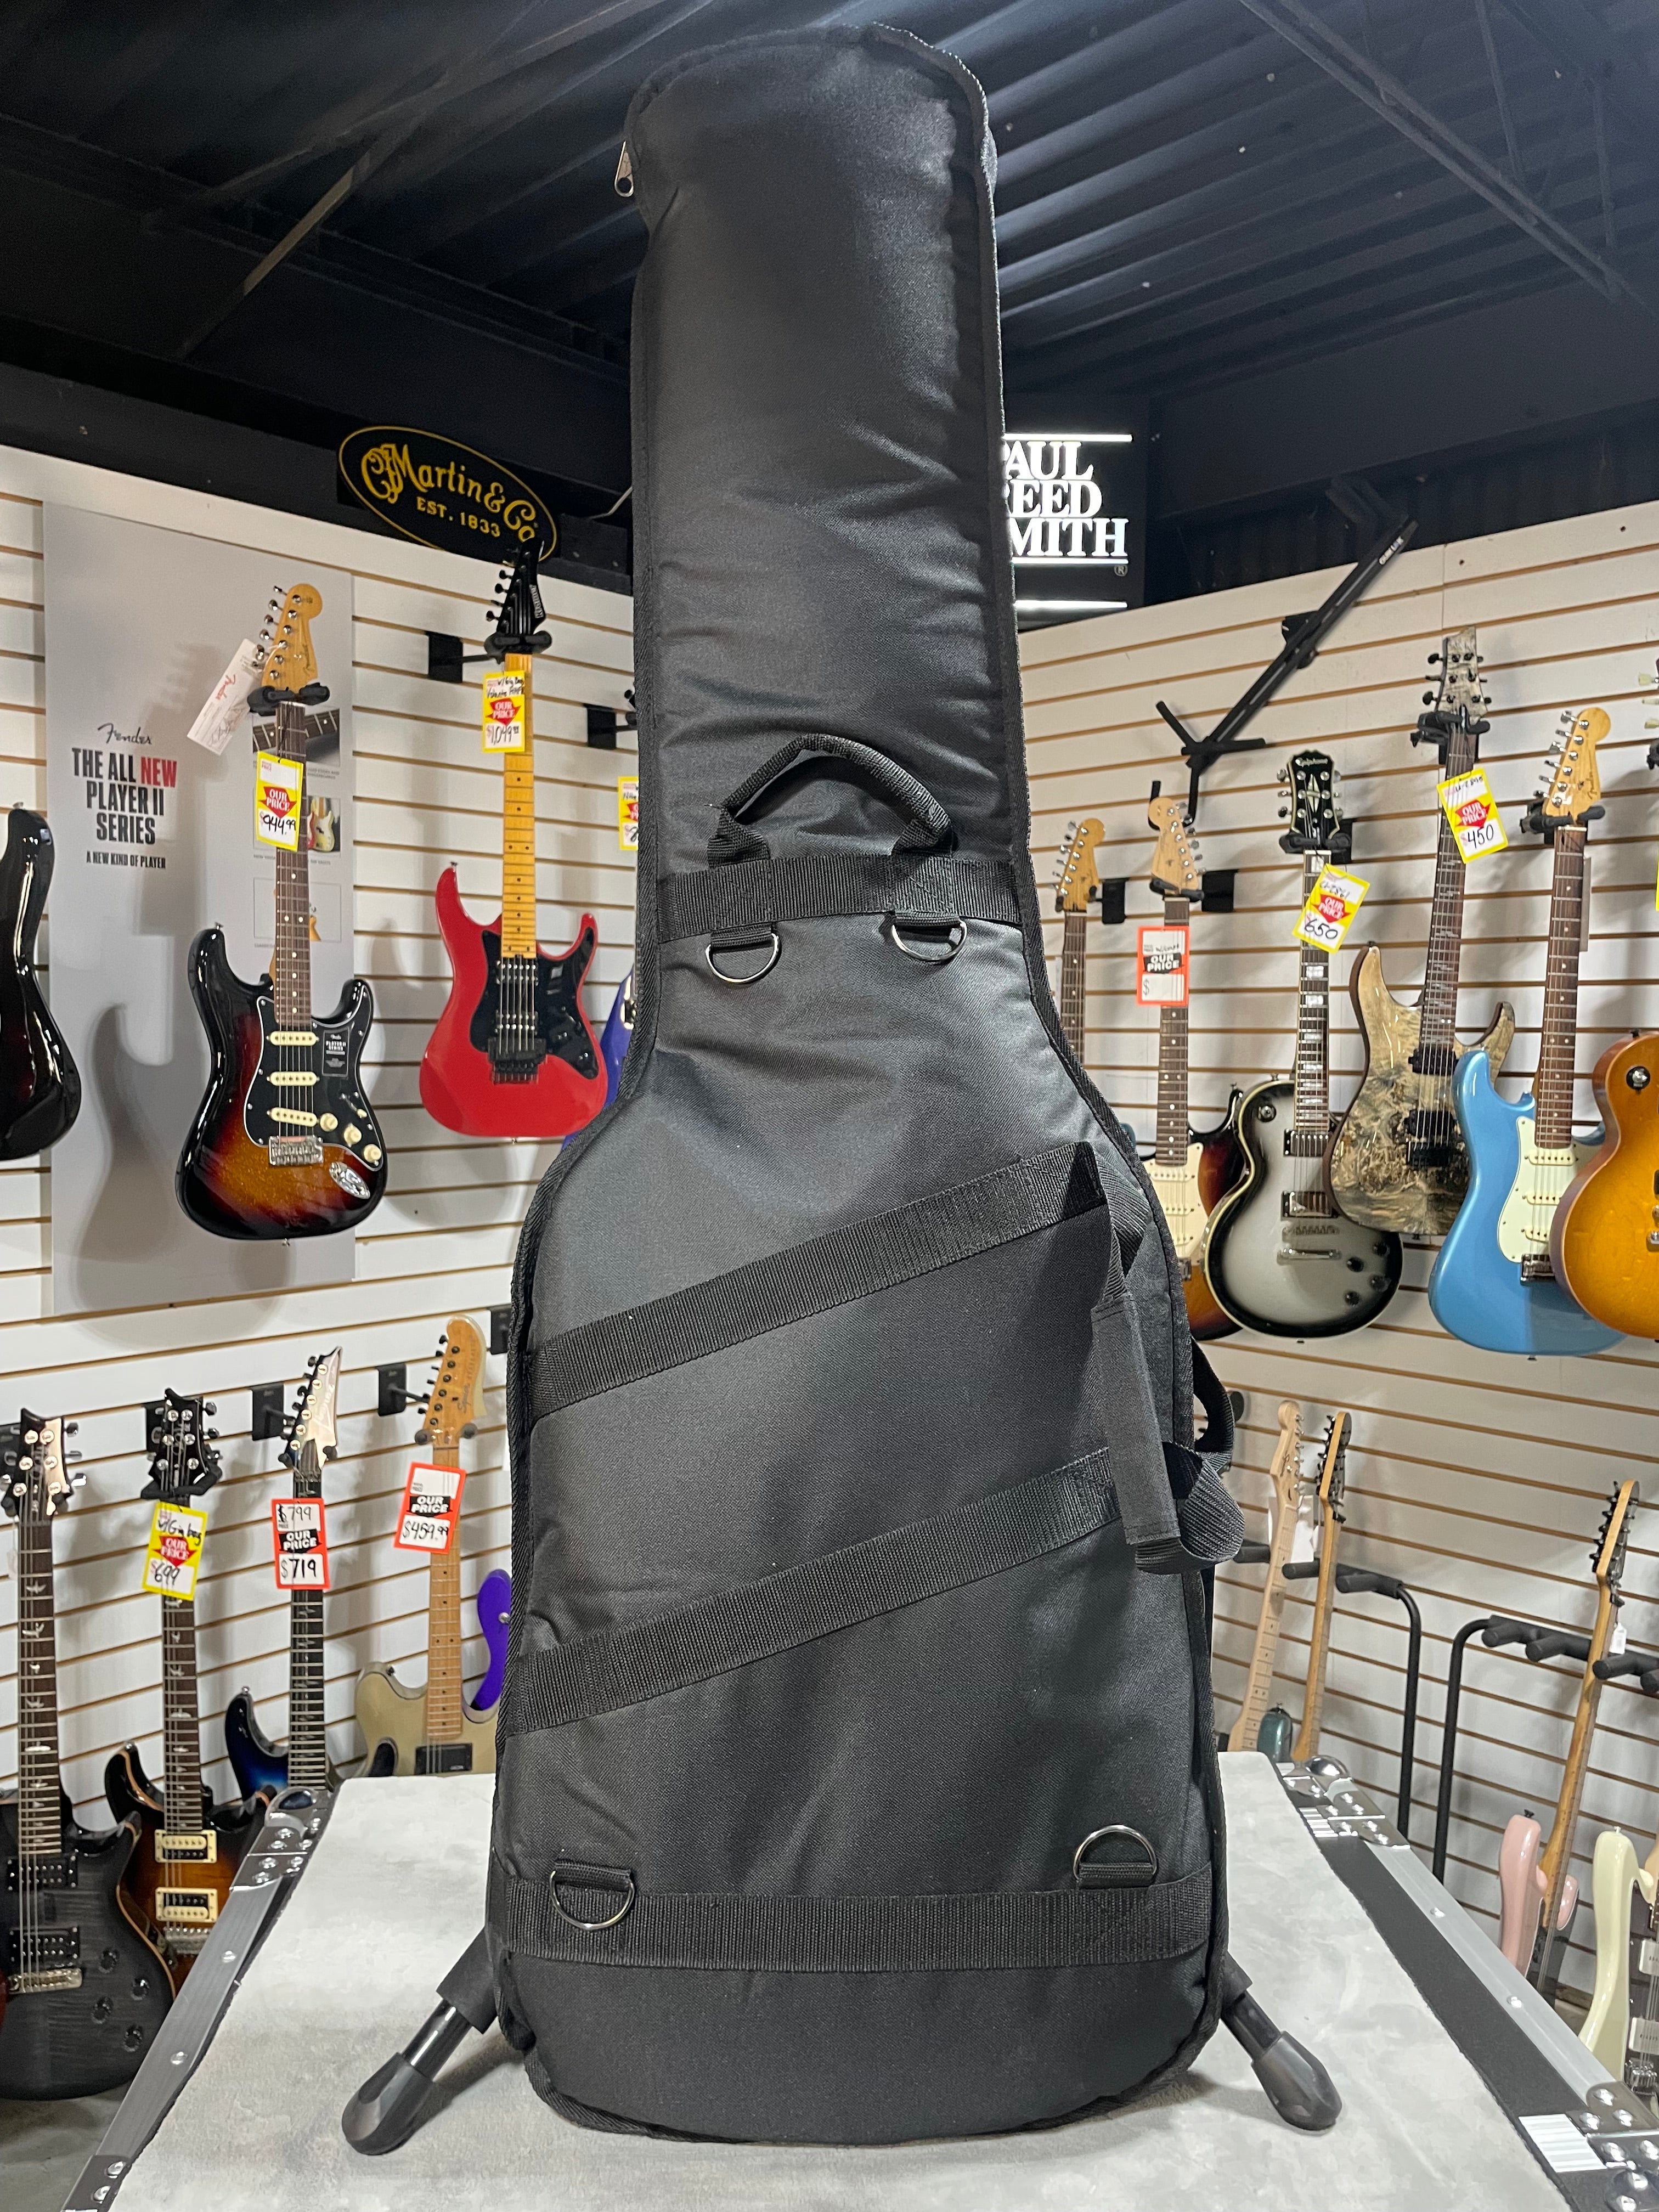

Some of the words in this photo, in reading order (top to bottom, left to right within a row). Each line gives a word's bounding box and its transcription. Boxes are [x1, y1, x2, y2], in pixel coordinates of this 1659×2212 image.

[1002, 441, 1093, 481] AUL
[1005, 480, 1103, 517] EED
[417, 496, 453, 521] EST.
[460, 512, 500, 538] 1833
[1009, 518, 1128, 556] MITH
[495, 701, 513, 711] OUR
[97, 723, 153, 744] Fender
[72, 747, 103, 780] THE
[108, 752, 137, 783] ALL
[141, 756, 178, 788] NEW
[87, 780, 149, 815] PLAYER
[153, 788, 165, 816] II
[269, 788, 288, 803] OUR
[266, 798, 290, 810] PRICE
[1462, 802, 1482, 816] OUR
[1462, 809, 1487, 826] PRICE
[96, 812, 156, 845] SERIES
[86, 851, 92, 864] A
[93, 851, 109, 865] NEW
[110, 853, 129, 866] KIND
[129, 855, 139, 867] OF
[140, 855, 166, 870] PLAYER
[1318, 902, 1344, 919] PRICE
[1324, 896, 1344, 912] OUR
[1147, 960, 1180, 972] PRICE
[1150, 953, 1174, 963] OUR
[416, 1496, 444, 1505] OUR
[410, 1504, 449, 1514] PRICE
[286, 1530, 311, 1542] OUR
[166, 1538, 188, 1552] OUR
[283, 1538, 318, 1551] PRICE
[160, 1545, 190, 1561] PRICE
[280, 1558, 317, 1579] $719
